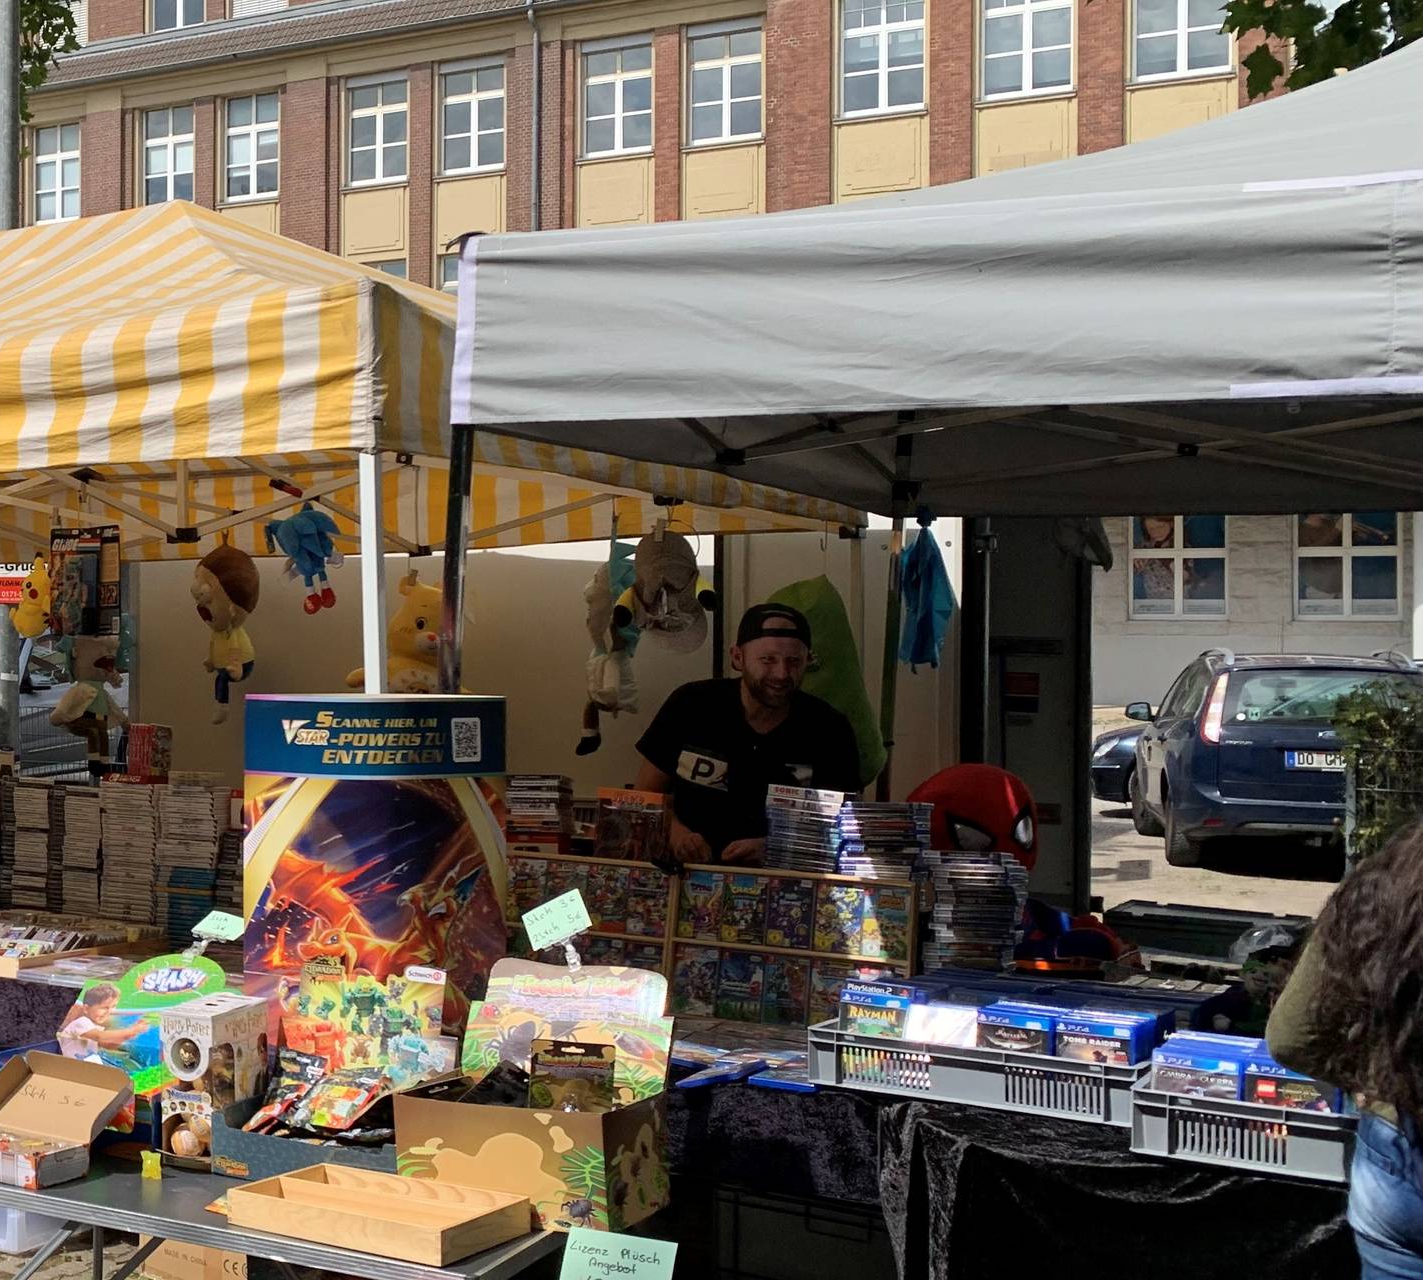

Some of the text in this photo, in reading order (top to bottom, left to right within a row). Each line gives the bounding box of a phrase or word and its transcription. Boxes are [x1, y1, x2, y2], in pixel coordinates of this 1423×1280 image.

[315, 711, 381, 729] SCANNE
[425, 732, 447, 746] ZU
[321, 750, 444, 765] ENTDECKEN
[1297, 753, 1314, 765] DO
[852, 995, 872, 1003] PS4
[848, 1005, 897, 1024] RAYMAN
[988, 1015, 1010, 1024] PS4
[1068, 1024, 1090, 1033] PS4
[1063, 1035, 1121, 1048] TOMB RAIDER
[1167, 1057, 1192, 1066] PS4
[1260, 1065, 1286, 1075] PS4
[569, 1239, 609, 1256] Lizenz
[588, 1257, 637, 1276] Angebot
